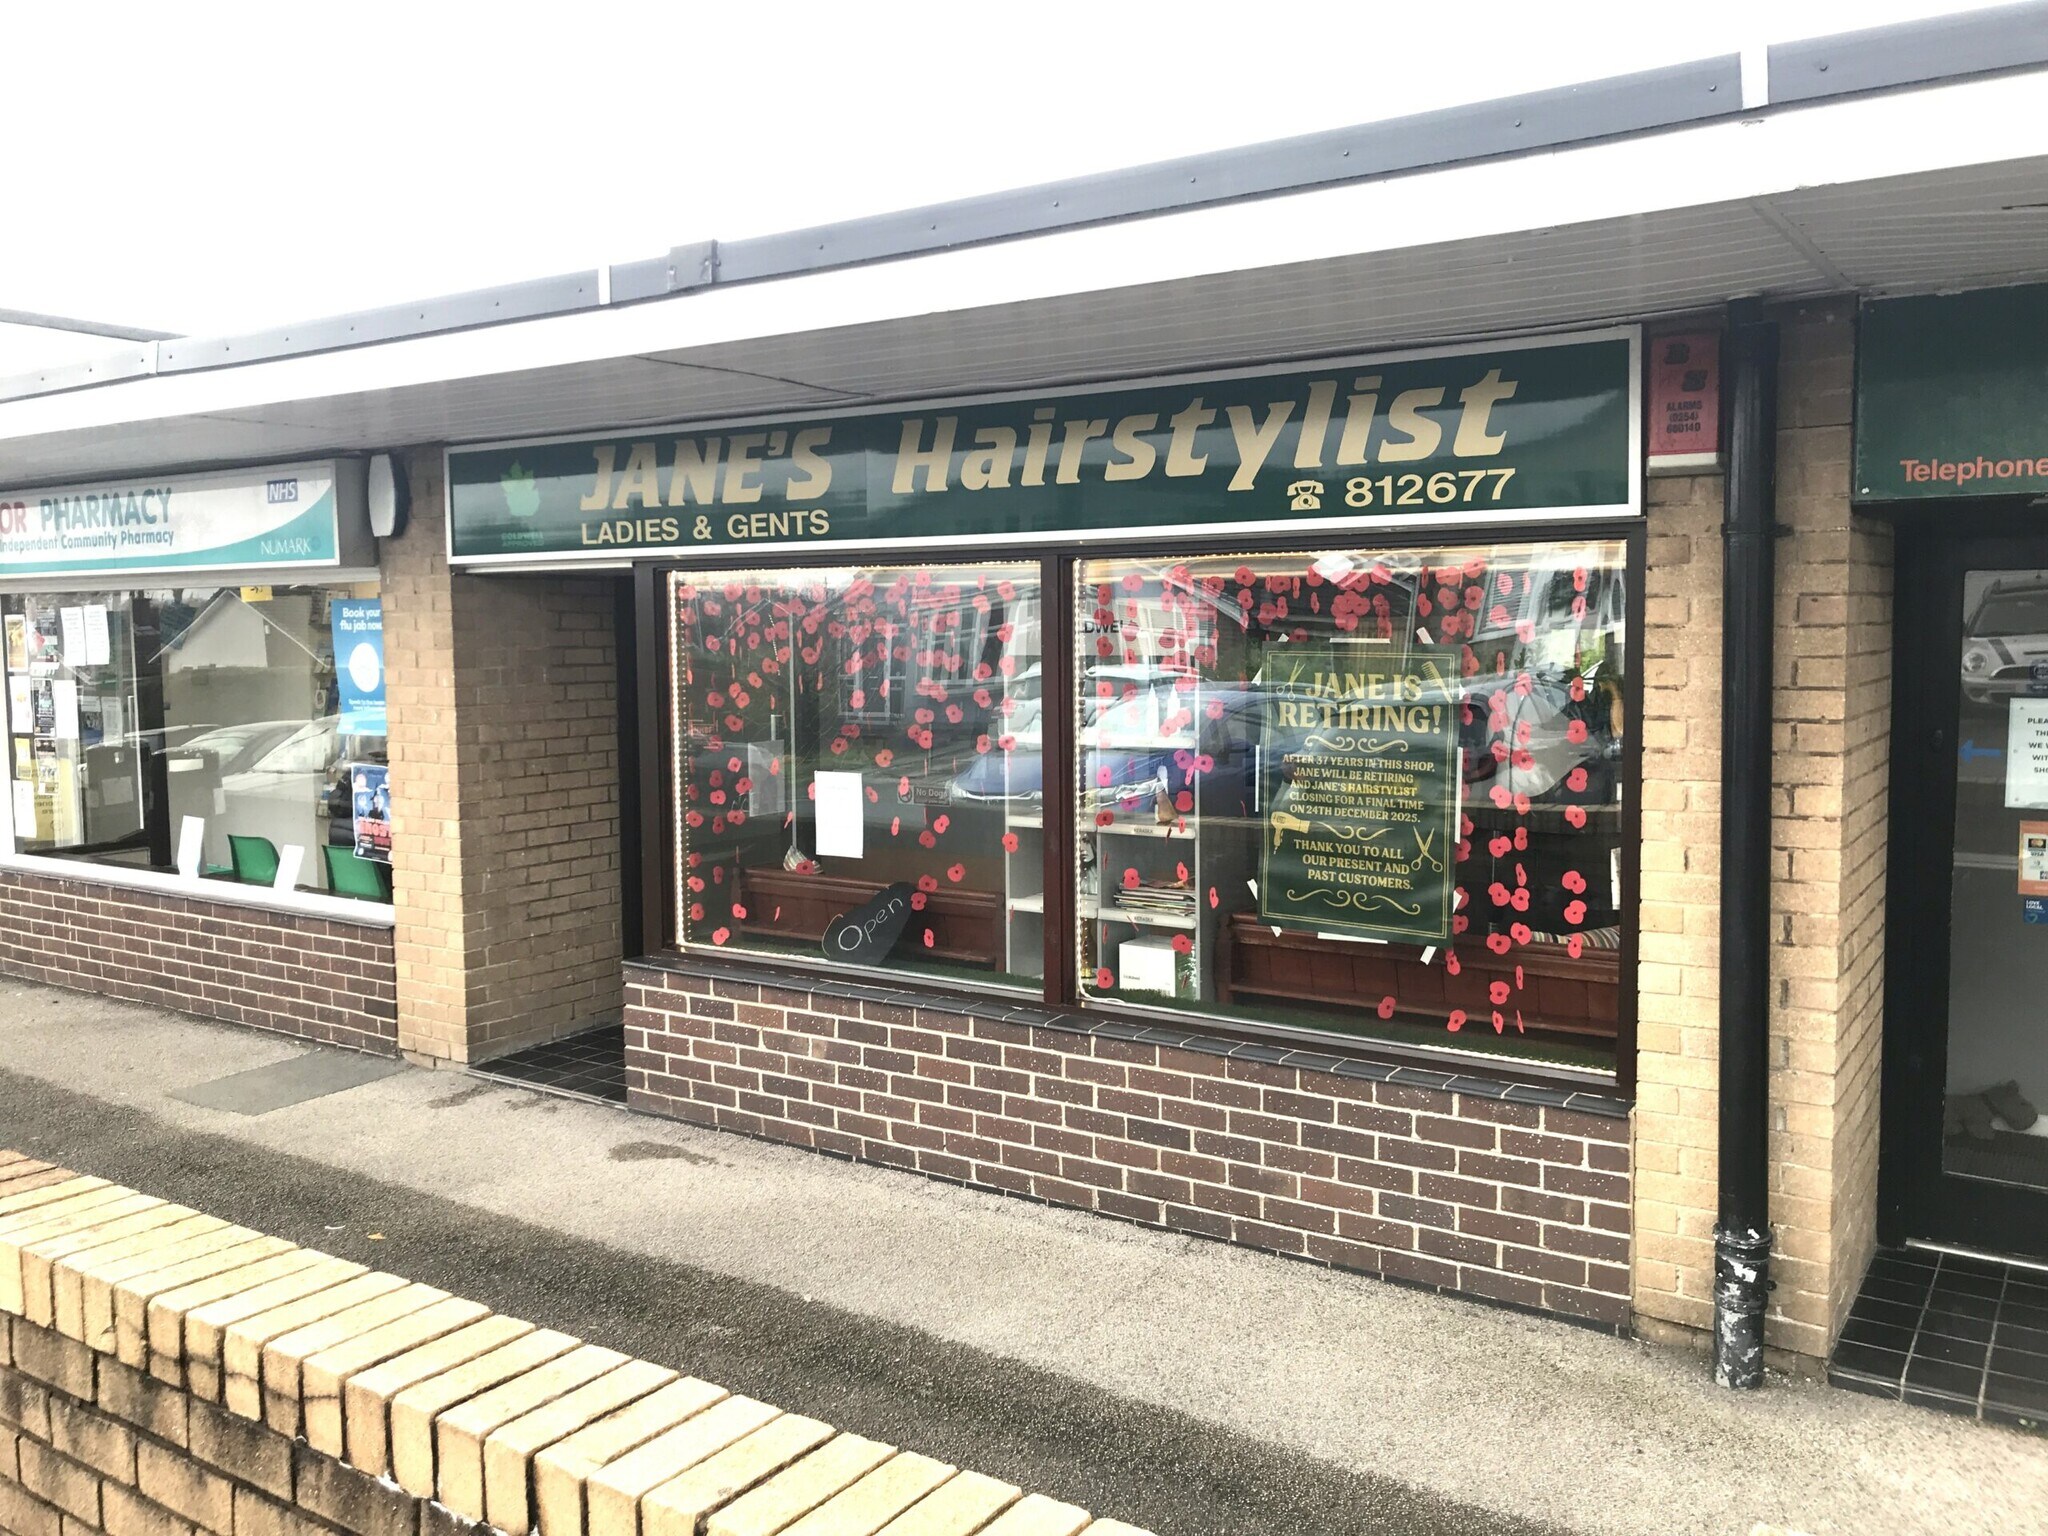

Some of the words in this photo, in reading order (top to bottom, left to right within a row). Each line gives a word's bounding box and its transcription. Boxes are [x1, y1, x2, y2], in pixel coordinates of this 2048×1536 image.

[1666, 400, 1703, 412] ALARMS
[579, 426, 834, 511] JANE'S
[891, 367, 1519, 493] Hairstylist
[1900, 456, 2048, 486] Telephone
[269, 481, 296, 501] NHS
[1344, 467, 1517, 509] 812677
[0, 501, 27, 534] OR
[40, 487, 172, 532] PHARMACY
[581, 515, 680, 545] LADIES
[692, 515, 714, 539] &
[727, 509, 830, 538] GENTS
[61, 530, 118, 550] Community
[121, 530, 175, 546] Pharmacy
[261, 537, 311, 556] NUMARK
[343, 606, 365, 618] Book
[366, 608, 381, 620] your
[340, 619, 352, 631] flu
[1305, 672, 1386, 700] JANE
[1393, 674, 1423, 702] IS
[1278, 701, 1442, 735] RETIRING!
[1283, 754, 1314, 764] AFTER
[1316, 755, 1329, 765] 37
[1330, 757, 1364, 767] YEARS
[1365, 758, 1376, 768] IN
[1377, 759, 1402, 769] THIS
[1404, 761, 1435, 773] SHOP.
[1294, 767, 1320, 777] JANE
[1321, 768, 1347, 779] WILL
[1349, 771, 1362, 780] BE
[1364, 771, 1414, 783] RETIRING
[916, 787, 927, 797] No
[1290, 779, 1311, 789] AND
[1312, 780, 1347, 792] JANE'S
[1348, 783, 1418, 797] HAIRSTYLIST
[1289, 791, 1333, 803] CLOSING
[1334, 795, 1355, 805] FOR
[1356, 796, 1364, 806] A
[1365, 797, 1396, 808] FINAL
[1397, 799, 1424, 811] TIME
[1290, 804, 1305, 814] ON
[1306, 805, 1332, 816] 24TH
[1334, 808, 1389, 820] DECEMBER
[1391, 811, 1421, 823] 2025.
[1294, 839, 1334, 853] THANK
[1335, 843, 1361, 855] YOU
[1362, 845, 1380, 857] TO
[1381, 848, 1405, 860] ALL
[1302, 854, 1327, 867] OUR
[1329, 856, 1383, 872] PRESENT
[1384, 862, 1410, 875] AND
[1308, 869, 1336, 882] PAST
[1338, 872, 1414, 890] CUSTOMERS.
[838, 898, 903, 951] Open
